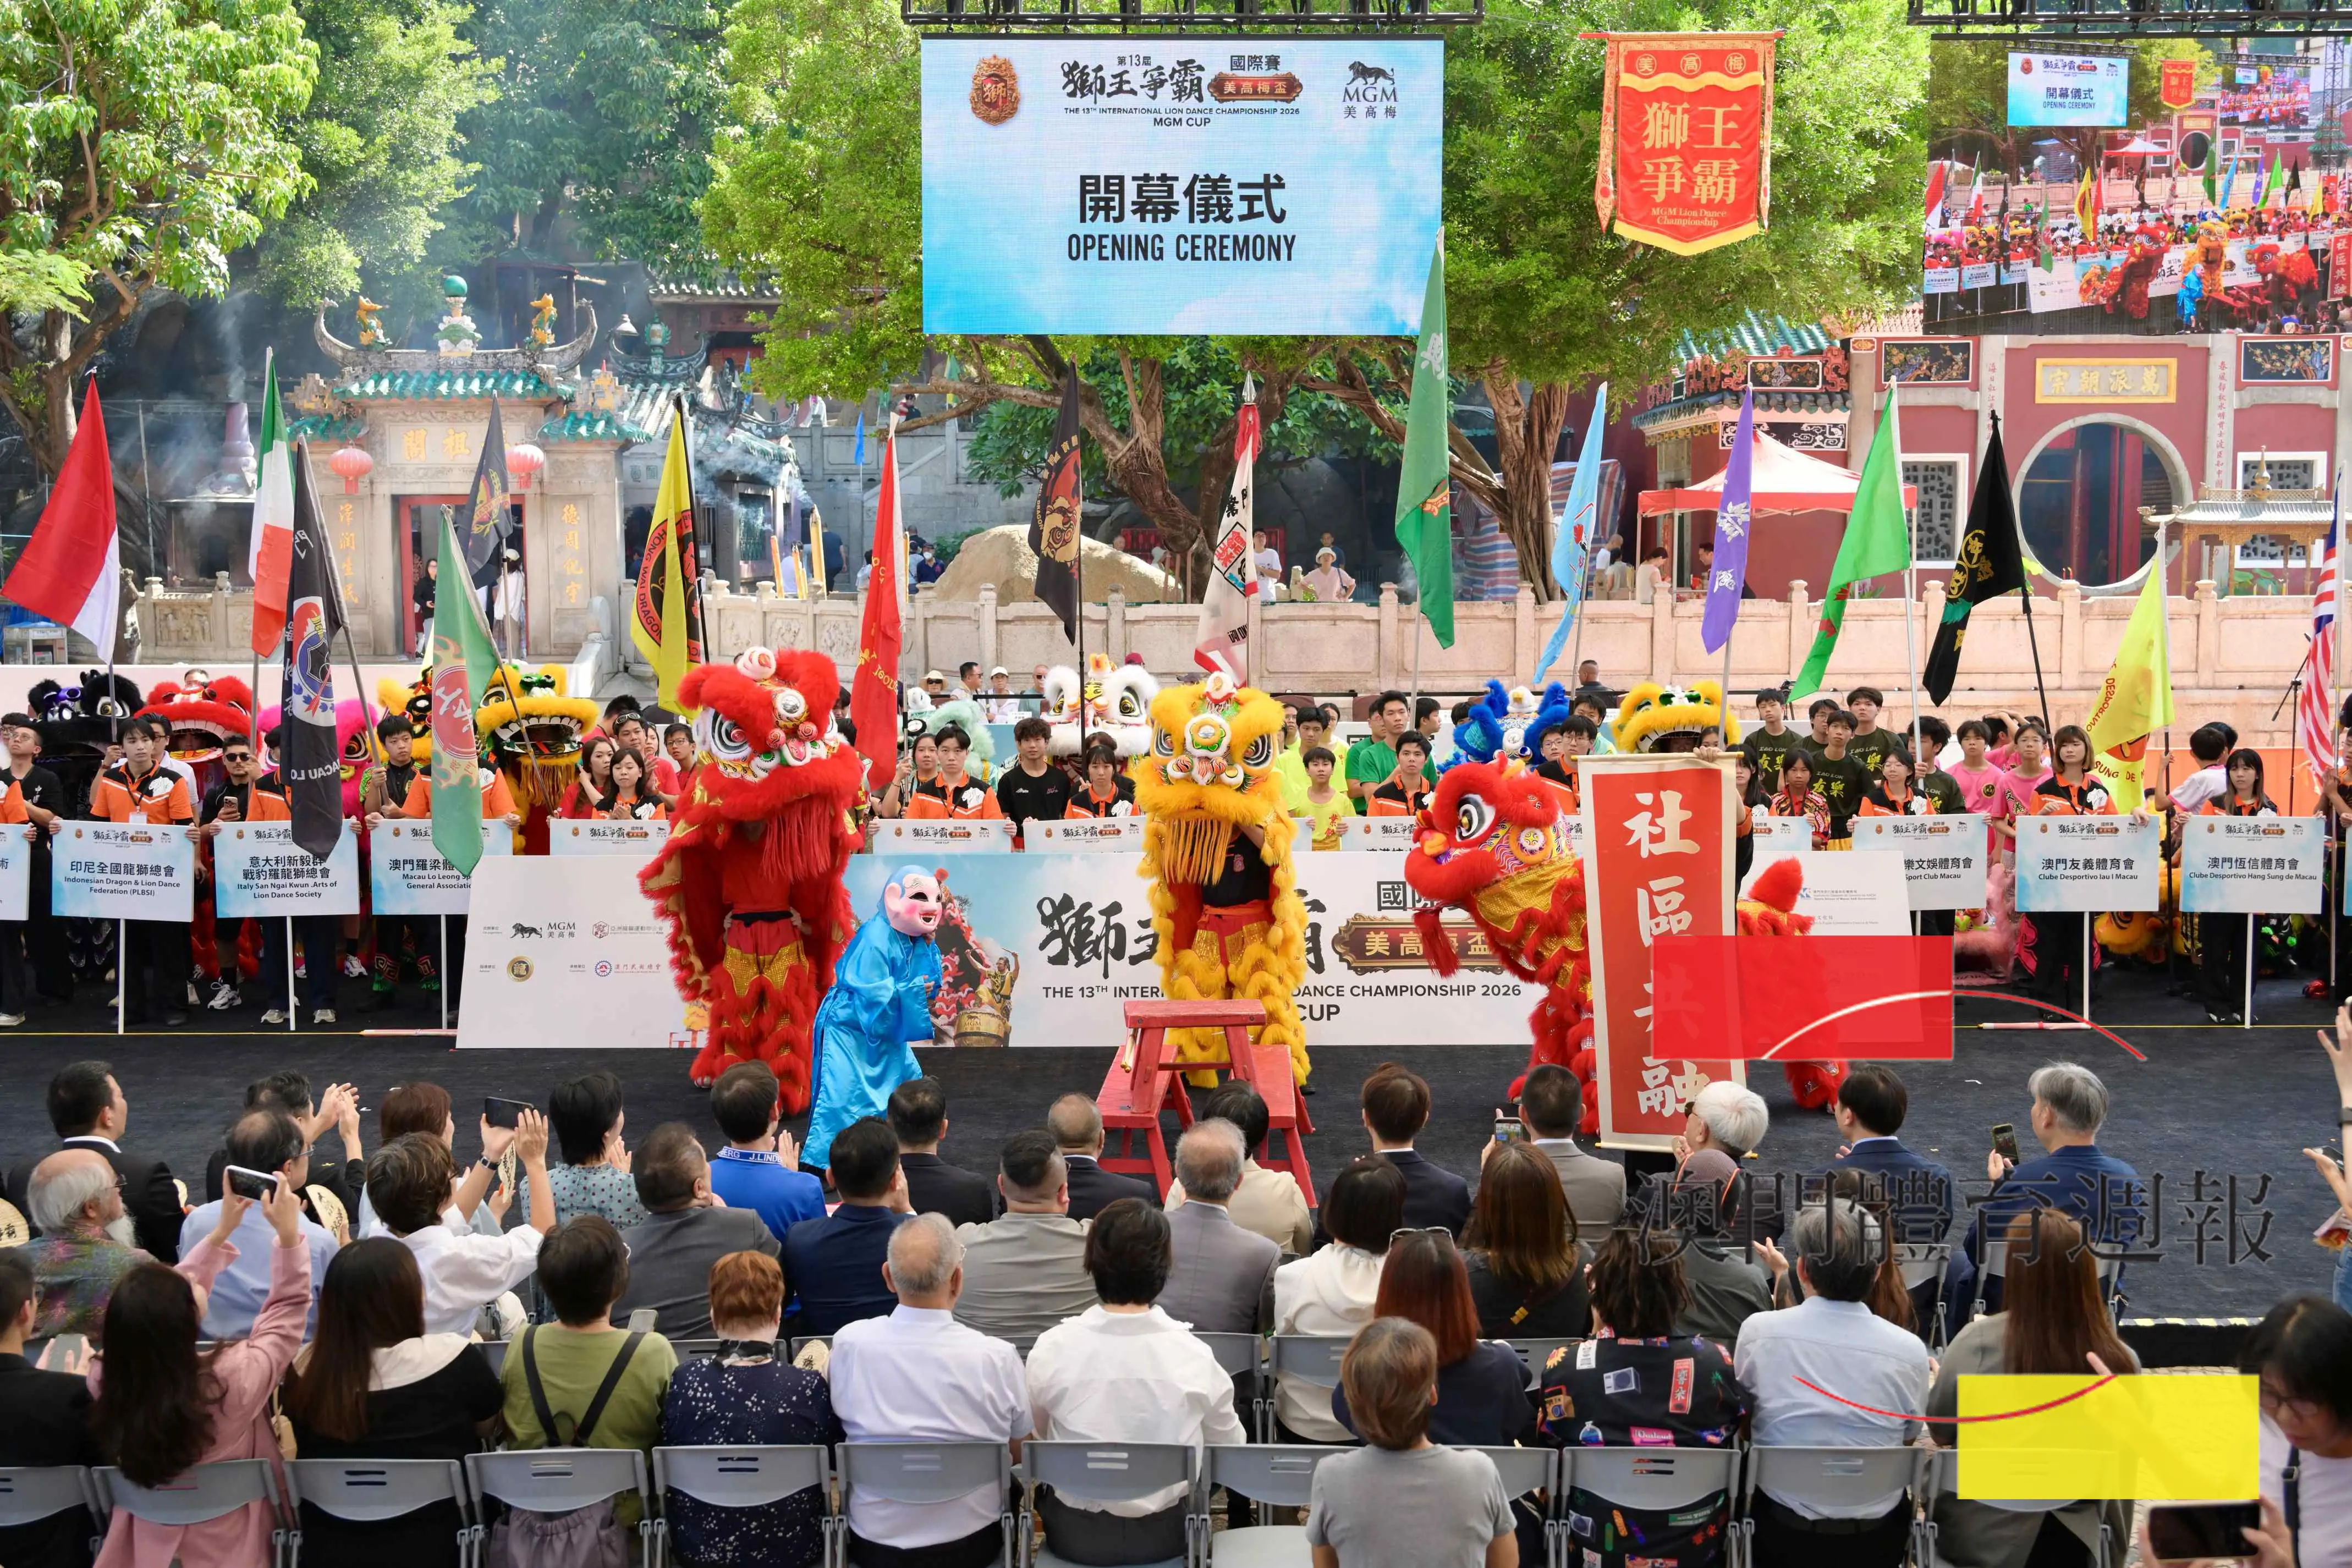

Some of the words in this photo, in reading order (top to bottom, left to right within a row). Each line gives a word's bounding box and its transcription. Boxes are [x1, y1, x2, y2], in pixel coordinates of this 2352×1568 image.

[1117, 54, 1152, 67] 第13屆
[1230, 55, 1281, 71] 國際賽
[1637, 53, 1744, 72] 美高梅
[1061, 59, 1206, 104] 獅王爭霸
[1224, 81, 1287, 95] 美高梅盃
[1342, 87, 1399, 102] MGM
[2046, 87, 2093, 100] 開幕儀式
[1343, 106, 1397, 119] 美高梅
[1153, 118, 1183, 127] MGM
[1186, 118, 1211, 127] CUP
[1642, 101, 1742, 150] 獅王
[1640, 155, 1740, 204] 爭霸
[1079, 173, 1287, 224] 開幕儀式
[1651, 207, 1678, 217] MGM
[1679, 207, 1698, 217] Lion
[1700, 208, 1727, 217] Dance
[1657, 216, 1718, 228] Championship
[1068, 234, 1164, 261] OPENING
[1176, 234, 1296, 261] CEREMONY
[645, 529, 667, 563] HONG
[638, 566, 649, 589] WAI
[2094, 761, 2119, 779] SUNG
[2125, 771, 2136, 783] DE
[1813, 778, 1845, 797] 友樂
[93, 830, 129, 843] 獅王爭霸
[590, 828, 625, 839] 獅王爭霸
[912, 827, 948, 839] 獅王爭霸
[1062, 826, 1098, 839] 獅王爭霸
[1893, 824, 1927, 835] 獅王爭霸
[2058, 824, 2095, 835] 獅王爭霸
[2225, 824, 2261, 836] 獅王爭霸
[70, 861, 175, 877] 印尼全國龍獅總會
[249, 856, 325, 868] 意大利新毅群
[1904, 857, 1973, 870] 樂文娛體育會
[2041, 858, 2135, 871] 澳門友義體育會
[2207, 857, 2300, 871] 澳門恆信體育會
[243, 867, 331, 881] 戰豹羅龍獅總會
[64, 876, 105, 884] Indonesian
[106, 878, 132, 887] Dragon
[547, 922, 575, 930] MGM
[1622, 789, 1712, 1119] 社區共融
[1042, 986, 1074, 999] THE
[1078, 986, 1108, 999] 13TH
[1113, 986, 1165, 999] INTER
[1349, 983, 1476, 997] CHAMPIONSHIP
[1481, 983, 1521, 997] 2026
[1298, 1004, 1340, 1021] CUP
